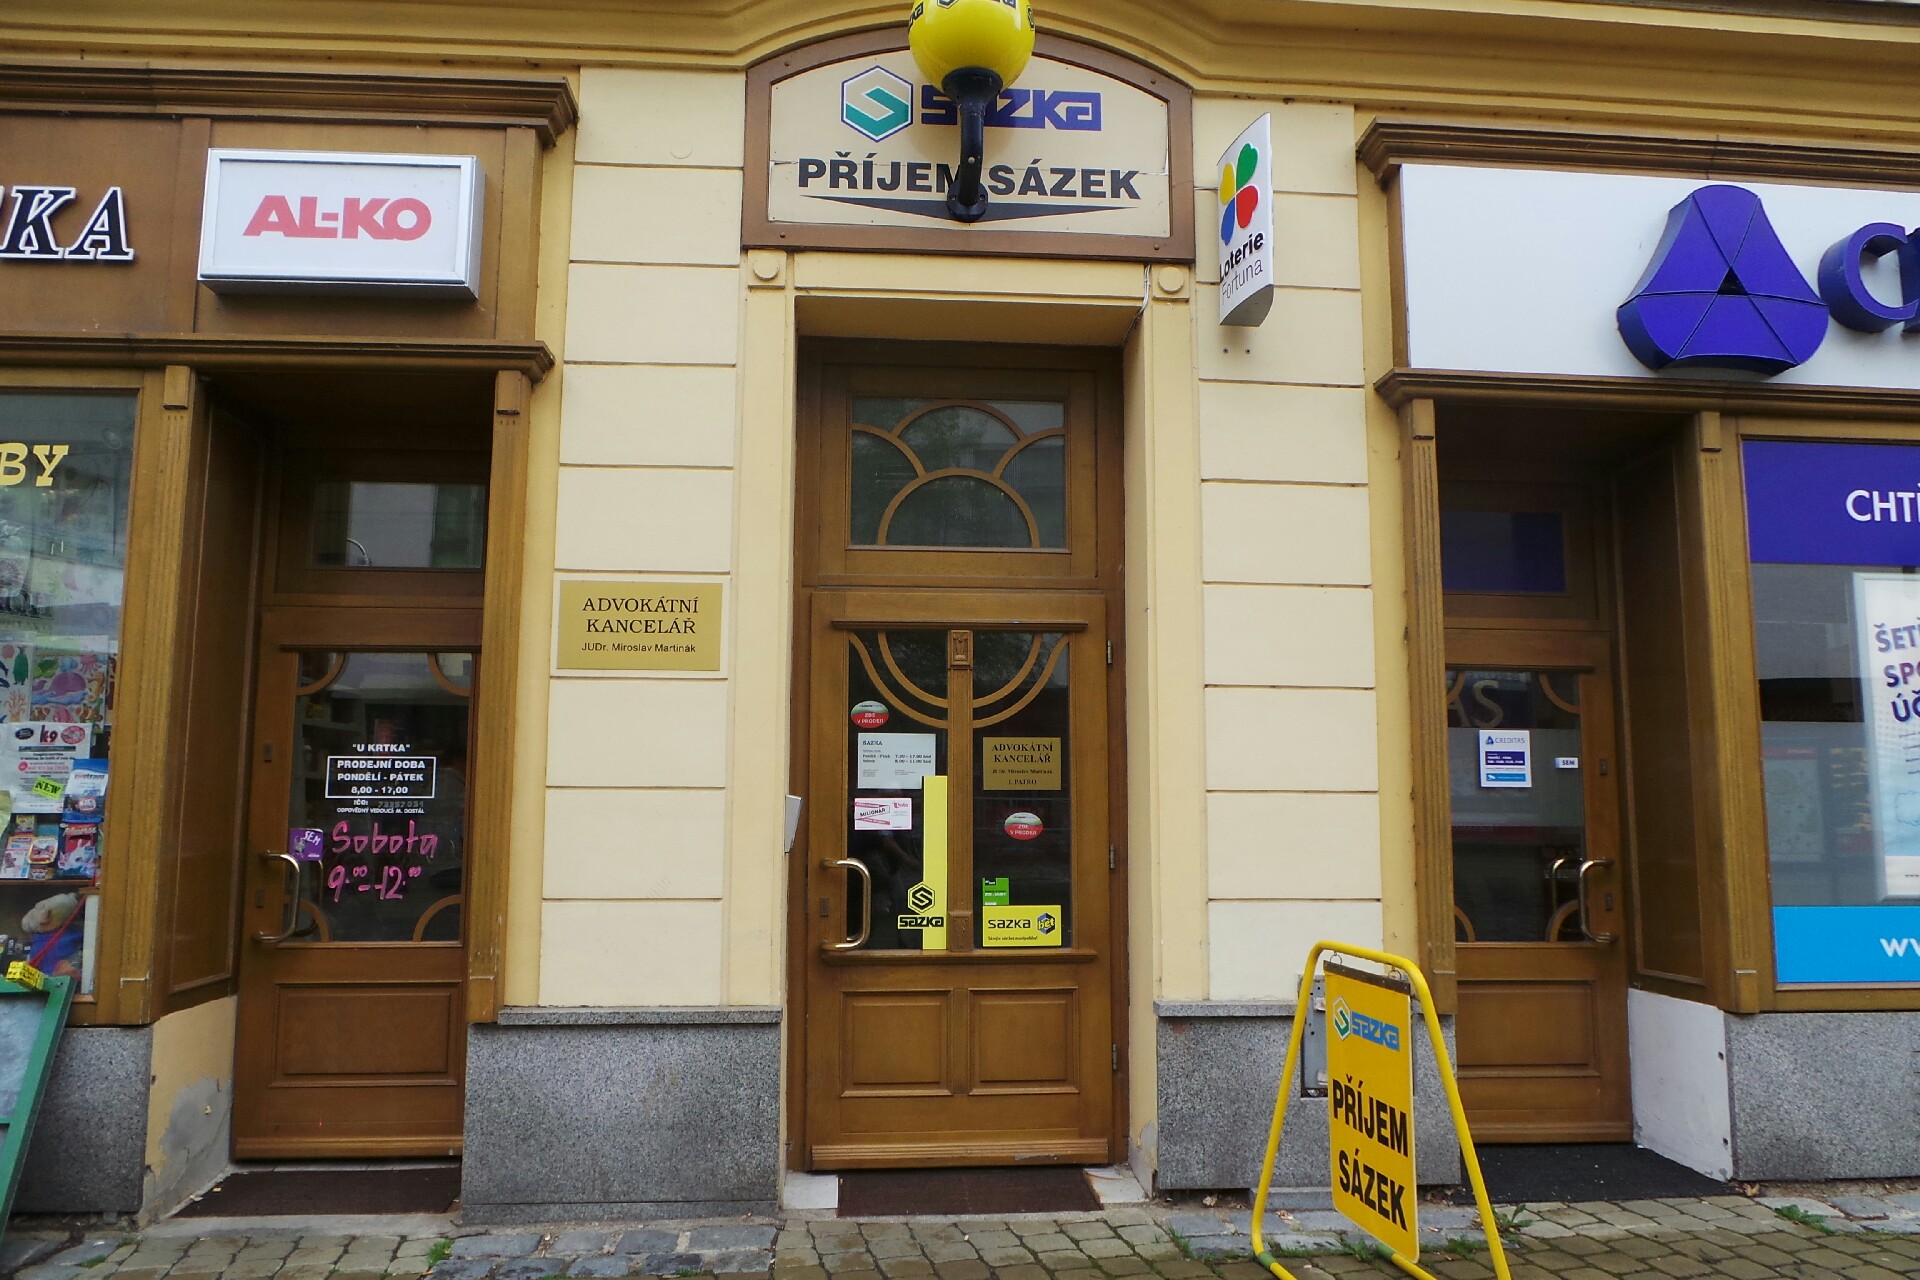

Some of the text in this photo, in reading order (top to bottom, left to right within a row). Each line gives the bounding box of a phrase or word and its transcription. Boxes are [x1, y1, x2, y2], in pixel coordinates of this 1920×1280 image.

[798, 151, 1141, 200] PŘÍJEM SÁZEK
[0, 185, 134, 260] KA
[242, 194, 432, 242] AL-KO
[1219, 231, 1264, 283] Loterie
[1221, 258, 1263, 305] Fortuna
[1818, 222, 1920, 334] c
[1846, 482, 1920, 523] CHT
[582, 596, 699, 613] ADVOKÁTNÍ
[586, 617, 696, 634] KANCELÁŘ
[1874, 617, 1920, 652] ŠET
[581, 642, 696, 653] JUDr. Miroslav Martinák
[1884, 660, 1920, 687] SP
[367, 744, 411, 752] KRTKA"
[992, 742, 1053, 752] ADVOKÁTNÍ
[994, 753, 1051, 763] KANCELÁŘ
[337, 759, 426, 769] PRODEJNÍ DOBA
[337, 771, 381, 781] PONDĚLÍ
[389, 772, 424, 781] PÁTEK
[34, 781, 61, 795] NEW
[351, 786, 372, 795] 8,00
[381, 786, 408, 795] 17,00
[302, 831, 321, 846] SEM
[332, 820, 438, 859] Sobota
[1037, 916, 1055, 930] bet
[1332, 1073, 1409, 1158] PŘÍJEM
[1338, 1148, 1408, 1232] SÁZEK
